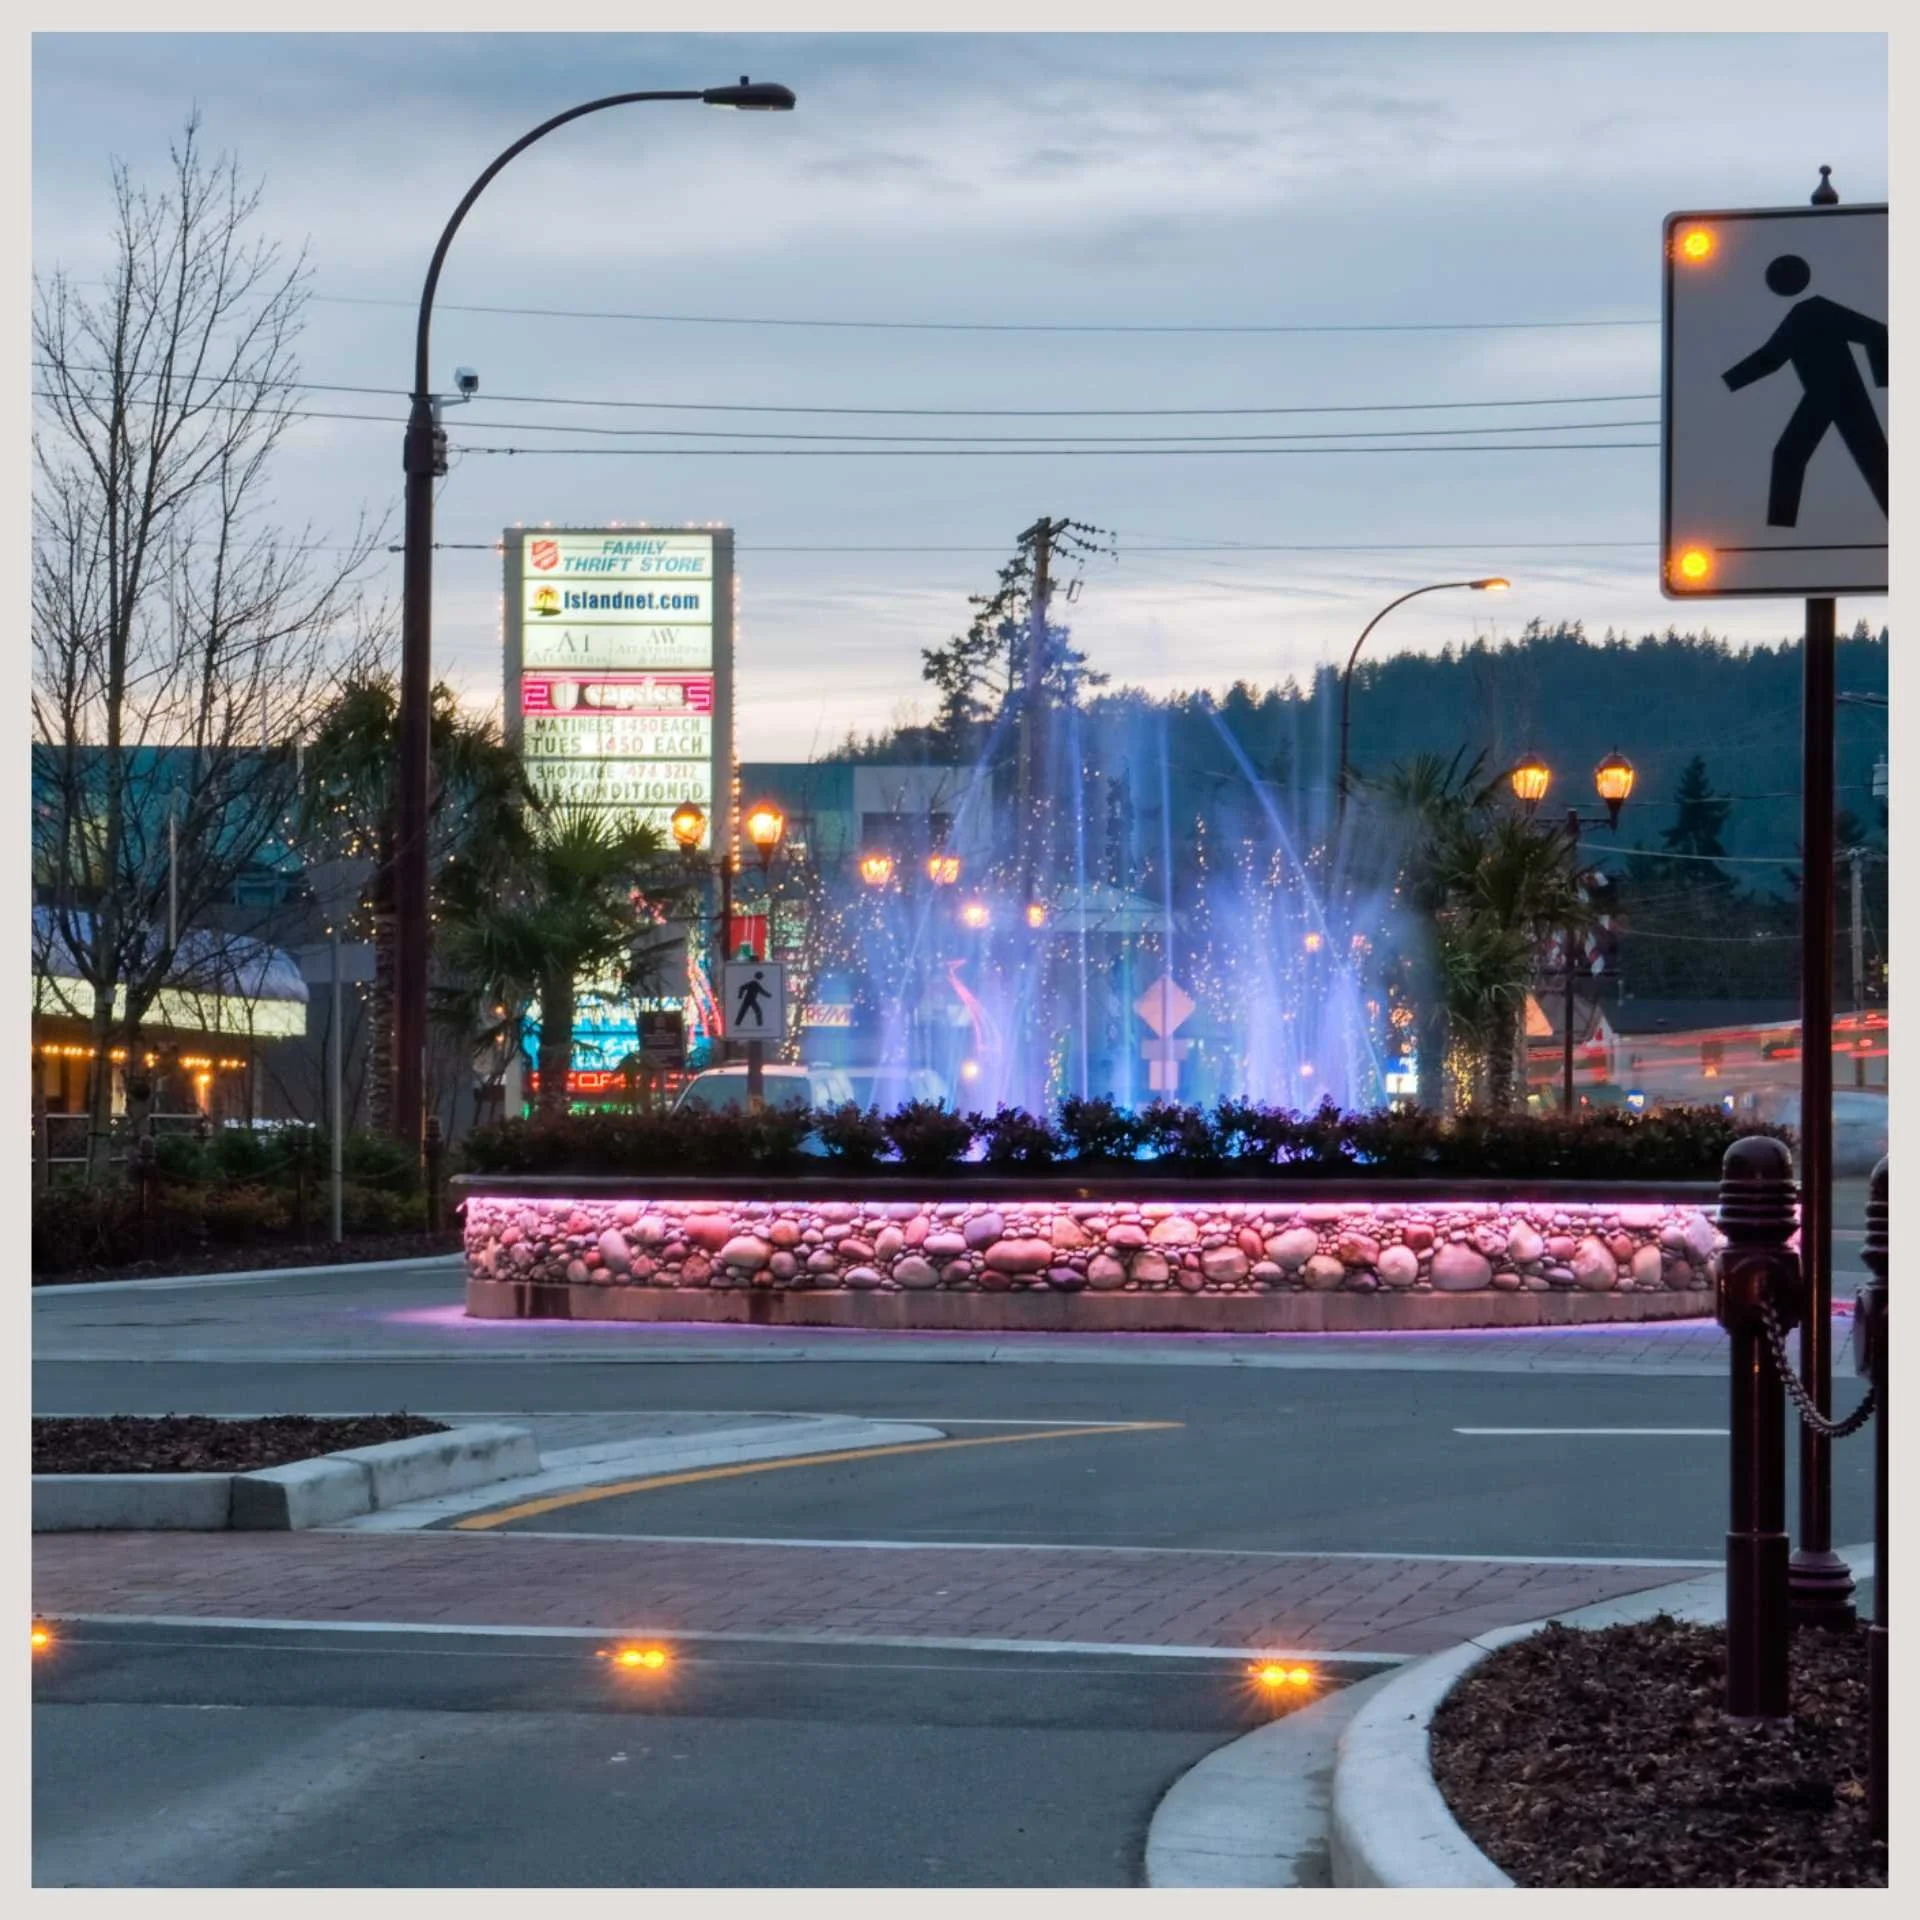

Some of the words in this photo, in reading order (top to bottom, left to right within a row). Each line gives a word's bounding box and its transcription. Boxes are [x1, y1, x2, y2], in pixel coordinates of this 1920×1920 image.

[602, 540, 667, 555] FAMILY
[563, 557, 632, 572] THRIFT
[639, 557, 705, 572] STORE
[564, 590, 700, 610] Islandnet.com
[531, 735, 582, 754] TUES
[655, 735, 702, 754] EACH
